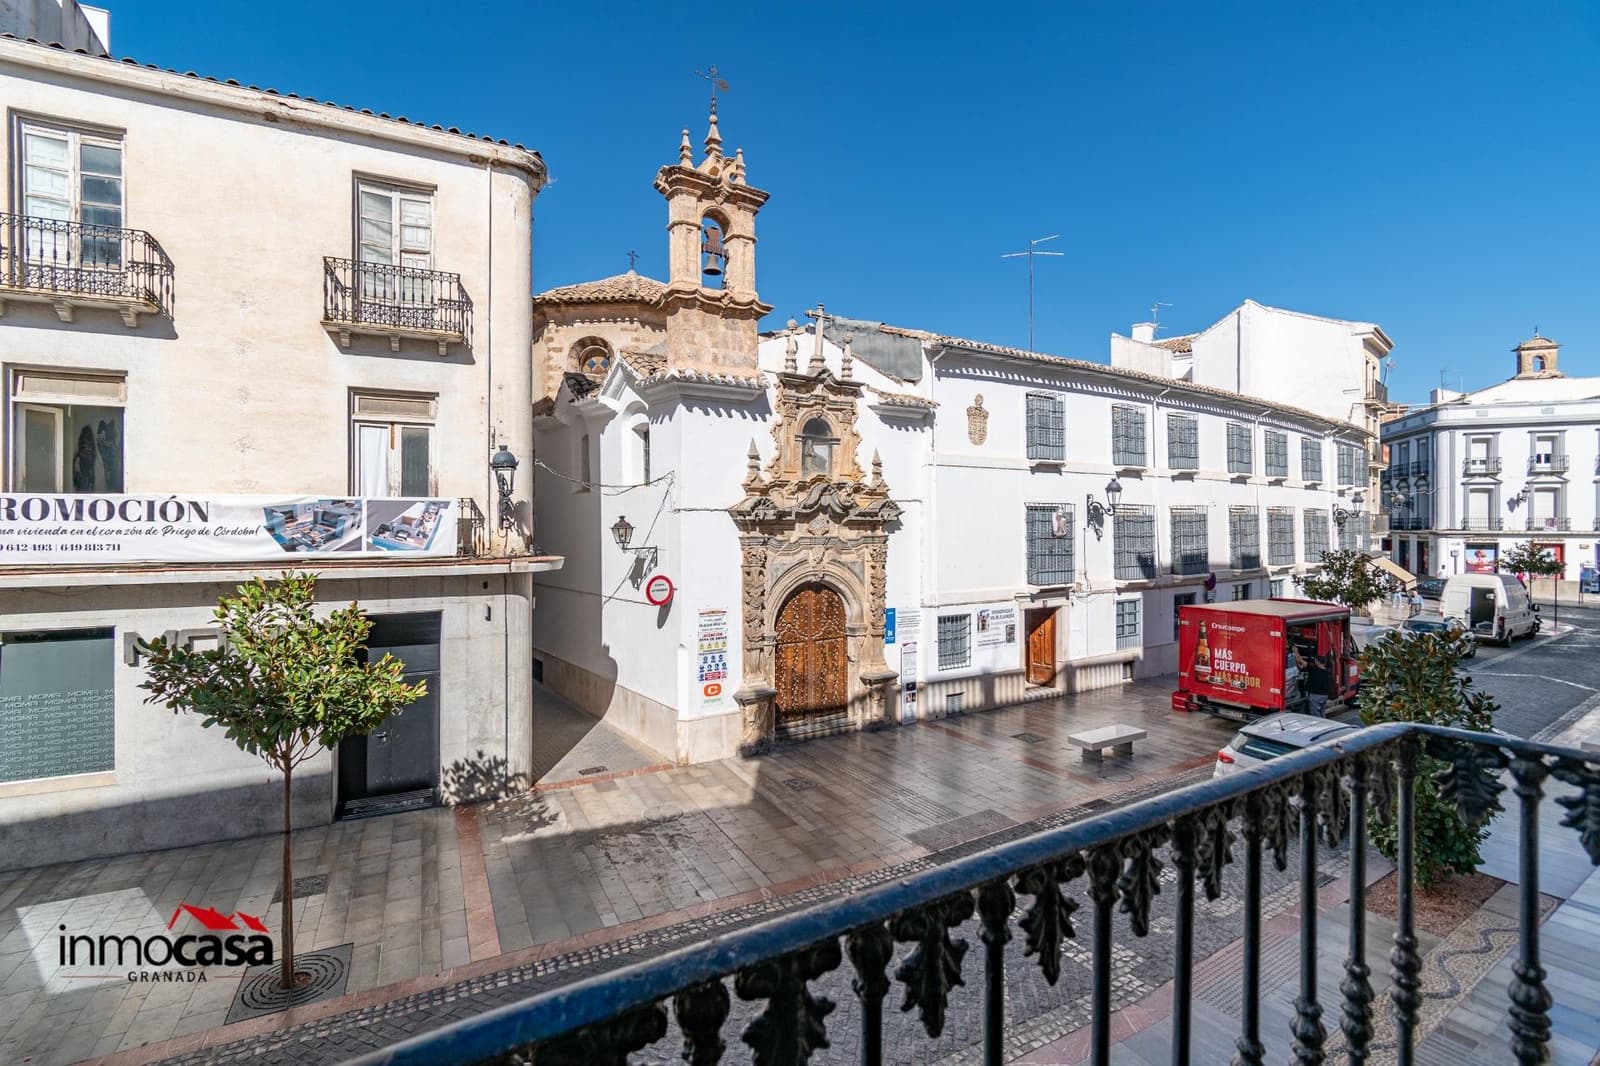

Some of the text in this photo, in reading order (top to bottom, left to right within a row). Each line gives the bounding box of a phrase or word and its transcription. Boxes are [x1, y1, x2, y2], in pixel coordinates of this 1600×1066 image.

[0, 495, 210, 523] ROMOCIÓN
[17, 527, 68, 536] vivienda
[86, 526, 98, 536] el
[99, 526, 143, 536] corazón
[145, 526, 159, 536] de
[161, 525, 197, 539] Priego
[198, 526, 211, 536] de
[1214, 648, 1232, 660] MÁS
[1214, 660, 1249, 676] CUERPO,
